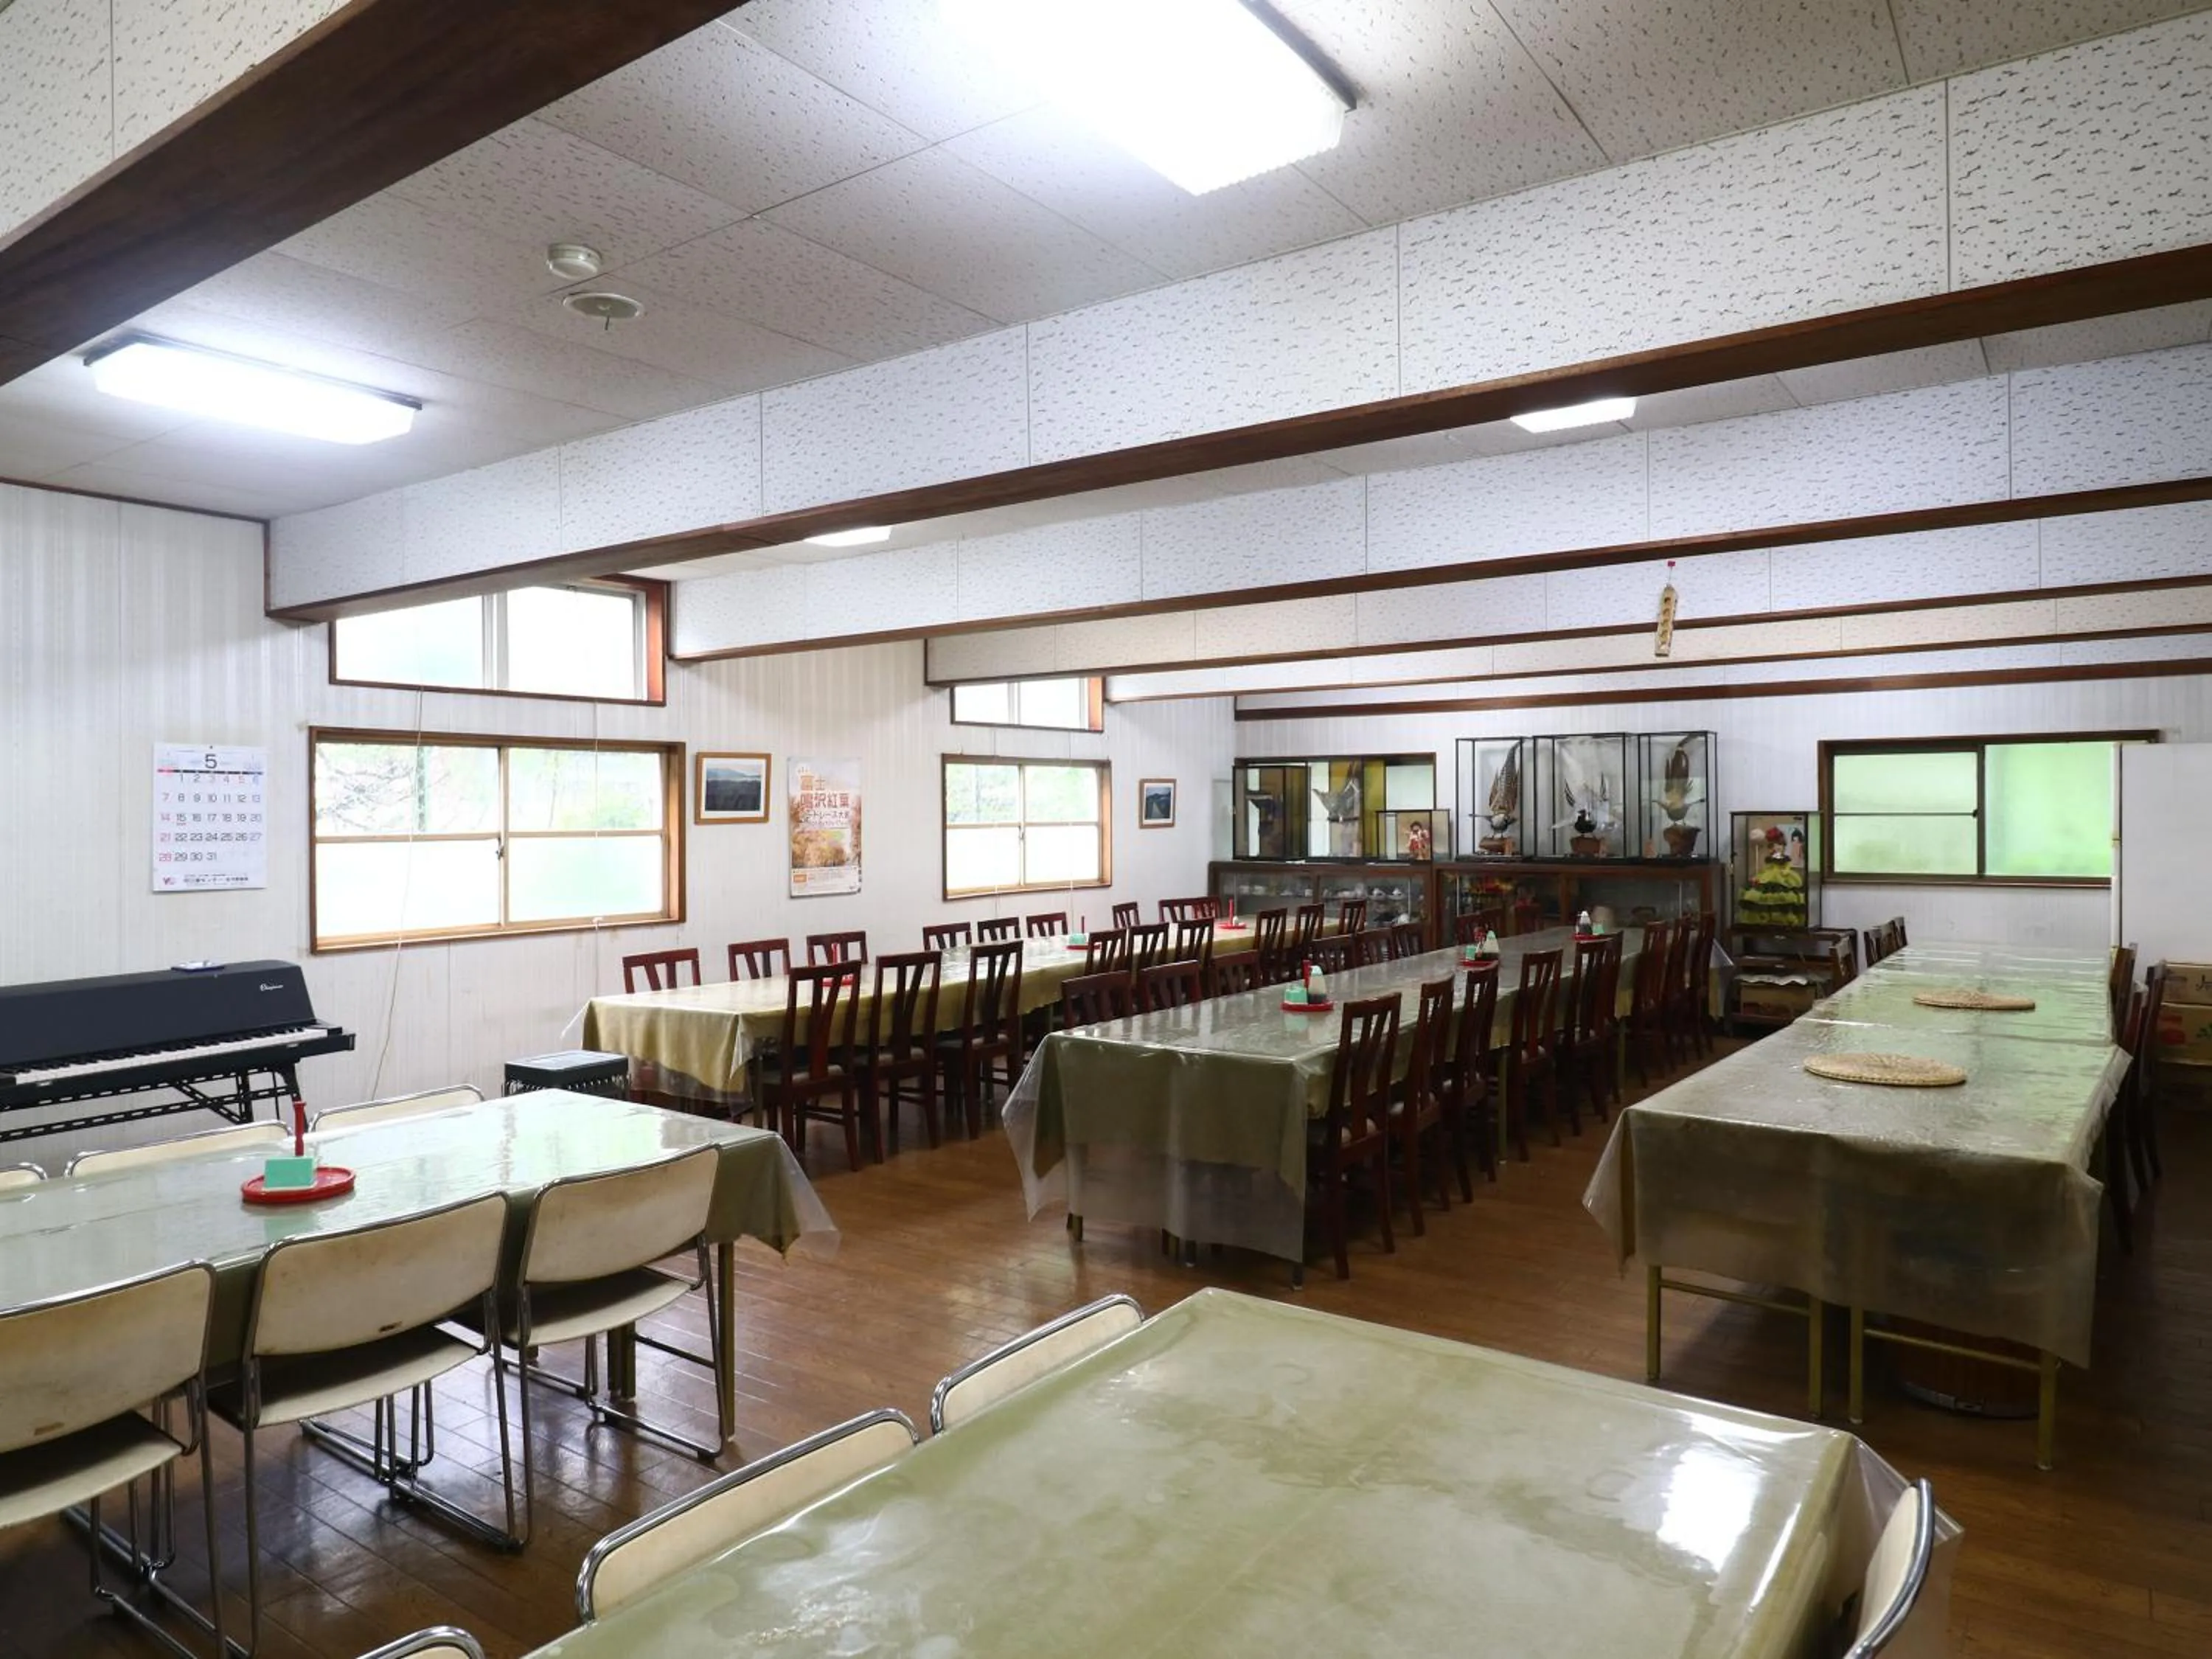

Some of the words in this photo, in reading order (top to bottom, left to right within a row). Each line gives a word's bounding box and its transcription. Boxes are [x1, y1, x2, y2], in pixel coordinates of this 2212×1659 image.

[204, 754, 218, 769] 5
[178, 793, 185, 802] 8
[208, 793, 218, 802] 10
[223, 794, 231, 802] 11
[237, 794, 246, 802] 12
[207, 813, 218, 822] 17
[223, 813, 232, 822] 18
[175, 832, 187, 842] 22
[189, 832, 203, 842] 23
[205, 832, 218, 842] 24
[235, 832, 248, 842] 26
